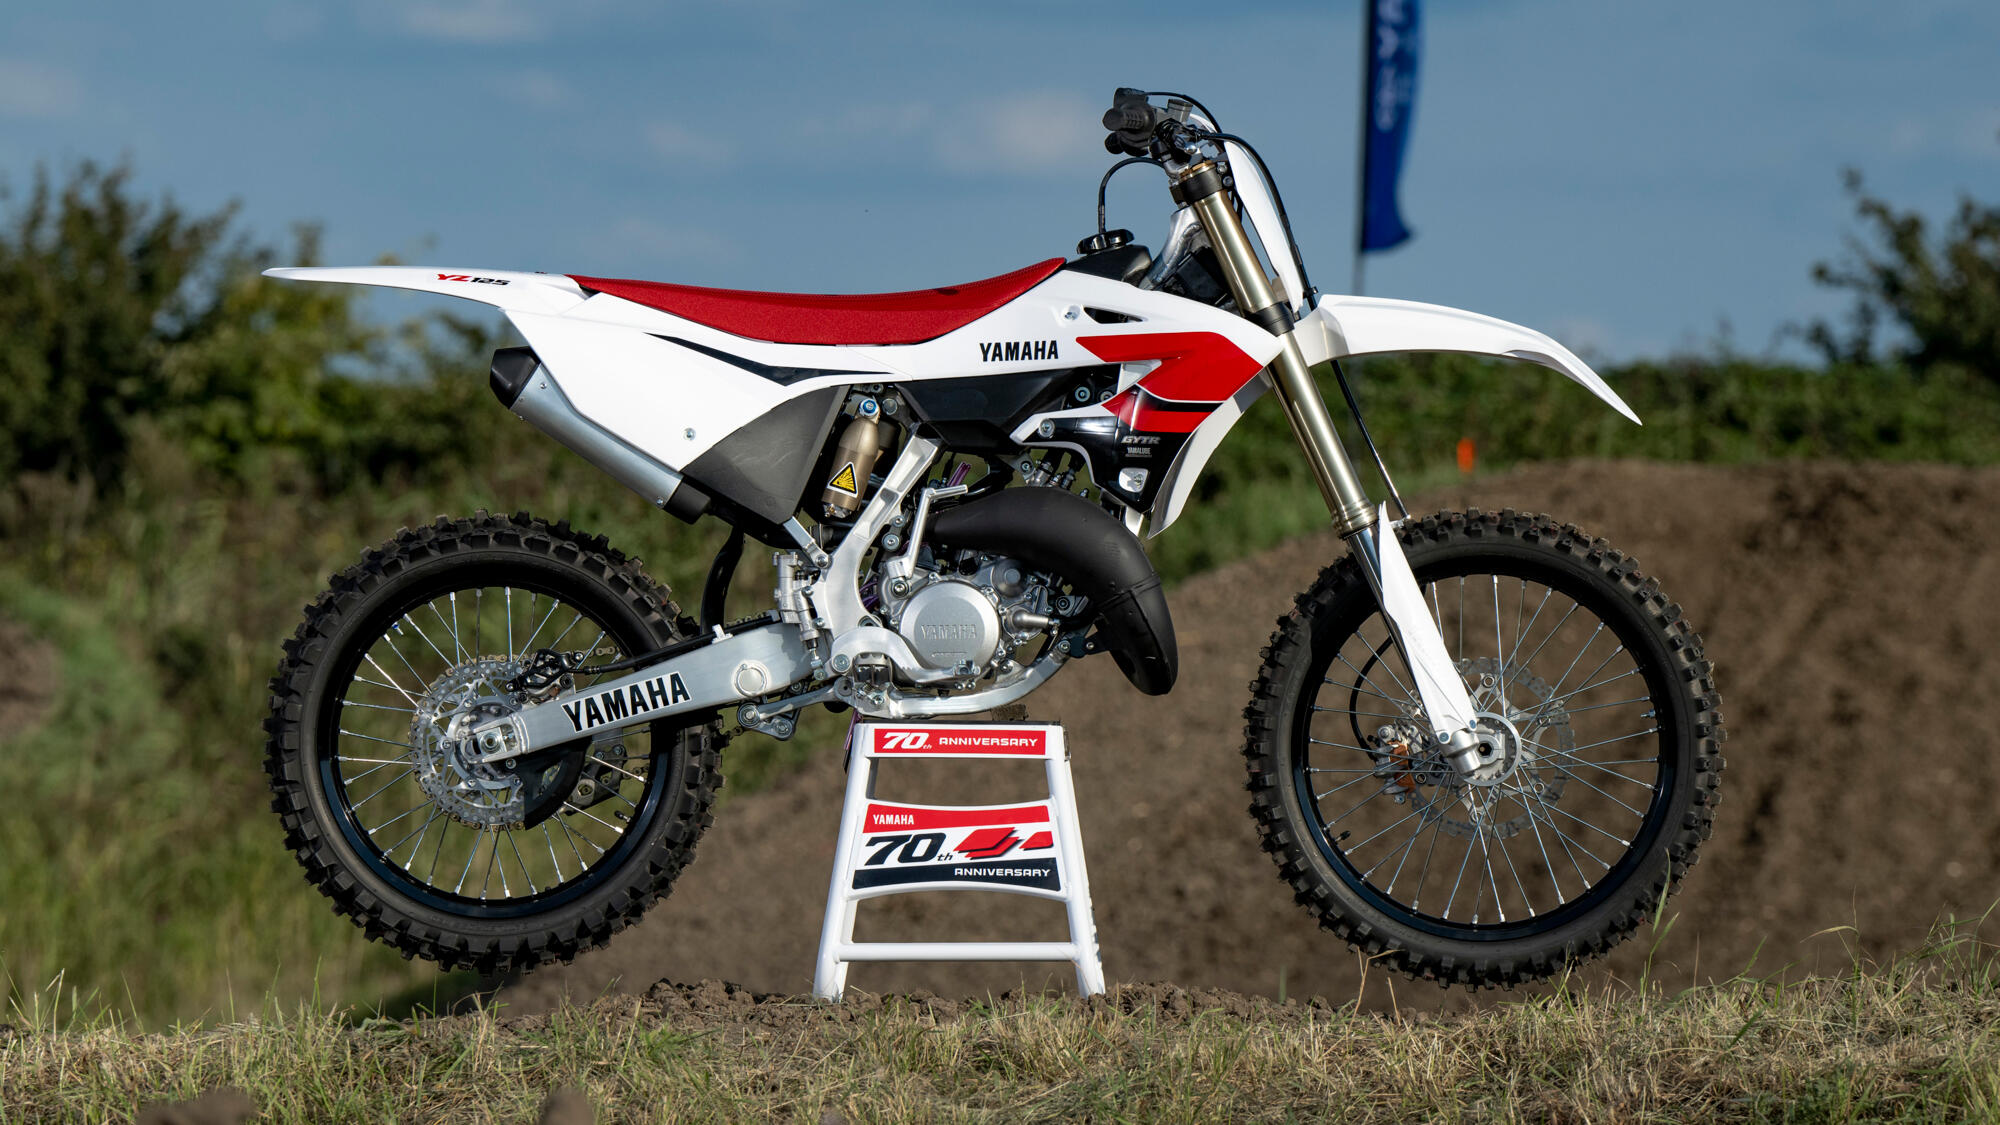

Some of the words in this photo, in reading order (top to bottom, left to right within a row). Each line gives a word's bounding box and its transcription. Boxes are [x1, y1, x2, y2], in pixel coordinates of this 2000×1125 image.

[437, 273, 511, 286] YZ125
[979, 340, 1059, 362] YAMAHA
[1121, 435, 1161, 444] GYTR
[921, 624, 977, 640] YAMAHA
[562, 673, 690, 732] YAMAHA
[882, 732, 932, 750] 70th
[939, 737, 1038, 747] ANNIVERSARY
[873, 814, 914, 825] YAMAHA
[864, 832, 953, 867] 70th
[954, 868, 1051, 877] ANNIVERSARY
